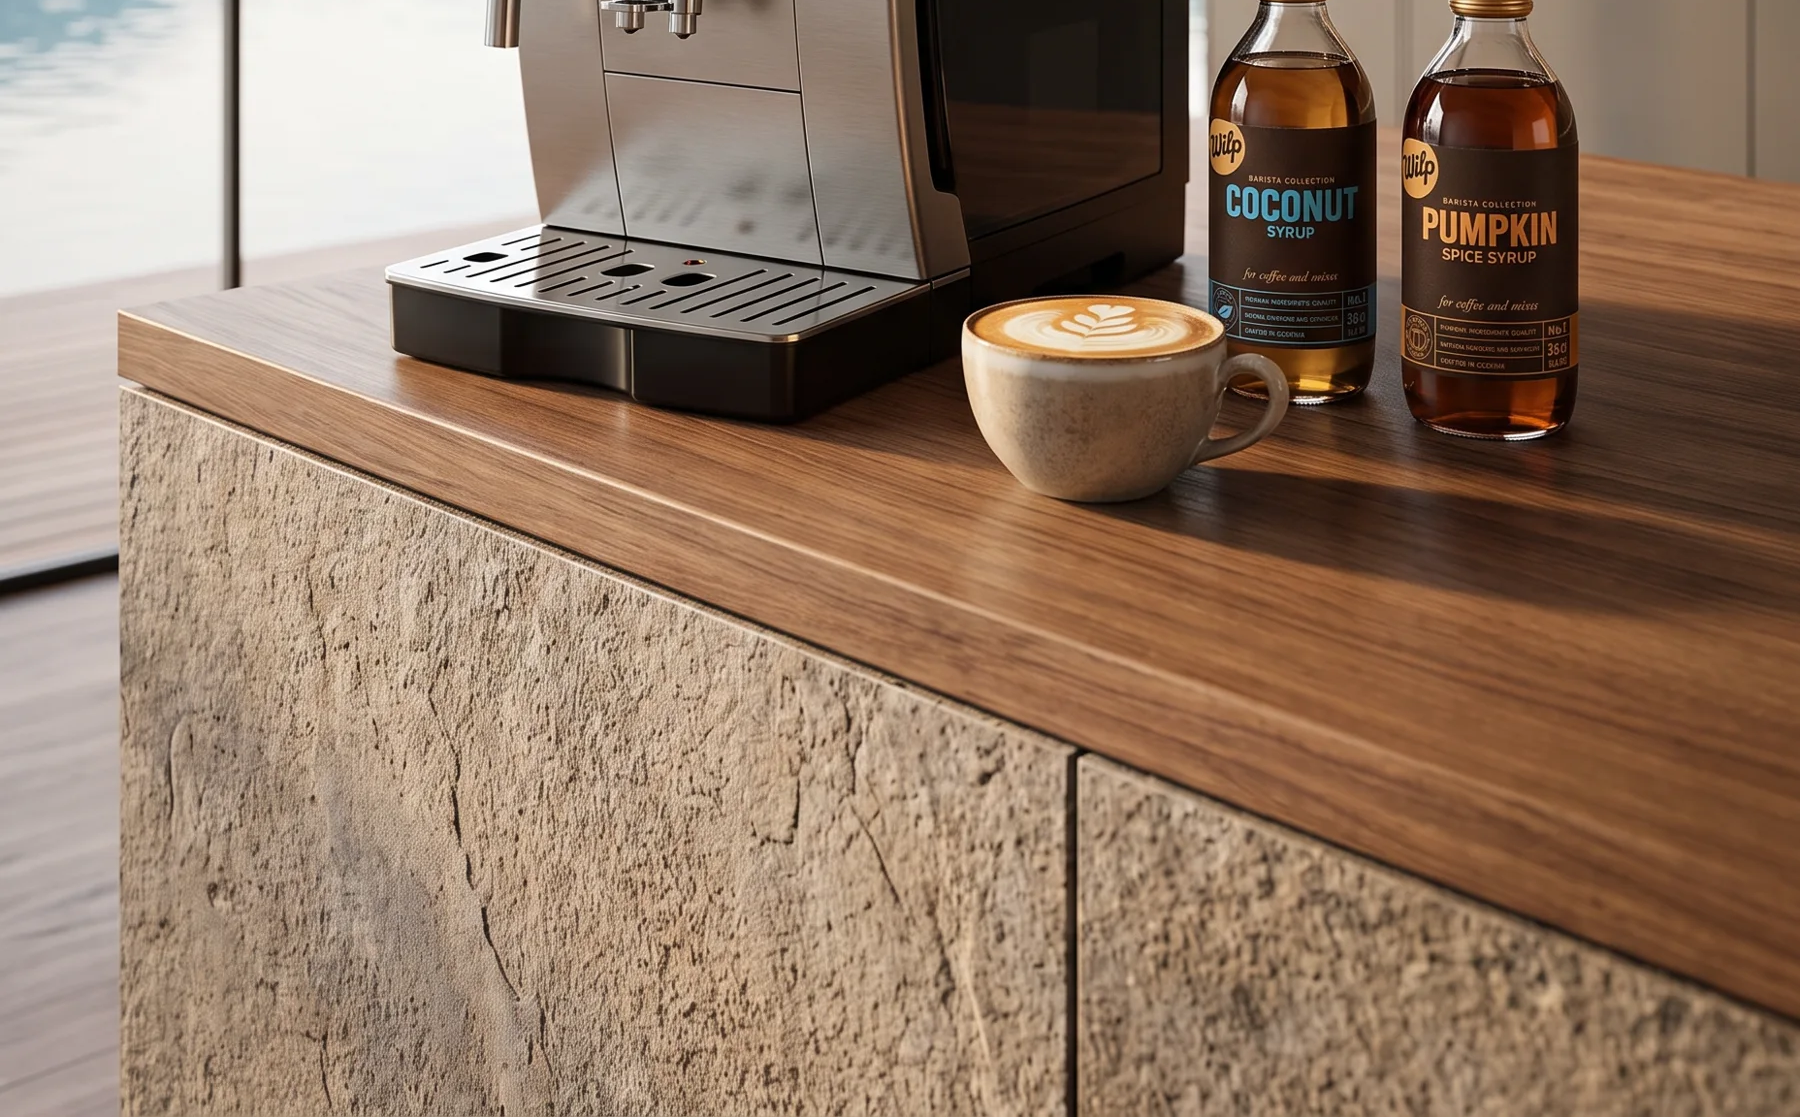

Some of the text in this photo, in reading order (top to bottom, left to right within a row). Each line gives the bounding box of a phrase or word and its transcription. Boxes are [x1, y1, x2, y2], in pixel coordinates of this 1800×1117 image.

[1210, 130, 1242, 163] Wilp
[1402, 150, 1435, 185] Wilp
[1248, 175, 1335, 185] BARISTA COLLECTION
[1226, 183, 1359, 223] COCONUT
[1442, 197, 1537, 209] BARISTA COLLECTION
[1267, 225, 1315, 239] SYRUP
[1422, 206, 1557, 248] PUMPKIN
[1442, 248, 1537, 265] SPICE SYRUP
[1437, 294, 1454, 310] for
[1455, 298, 1484, 312] coffee
[1487, 300, 1510, 311] and
